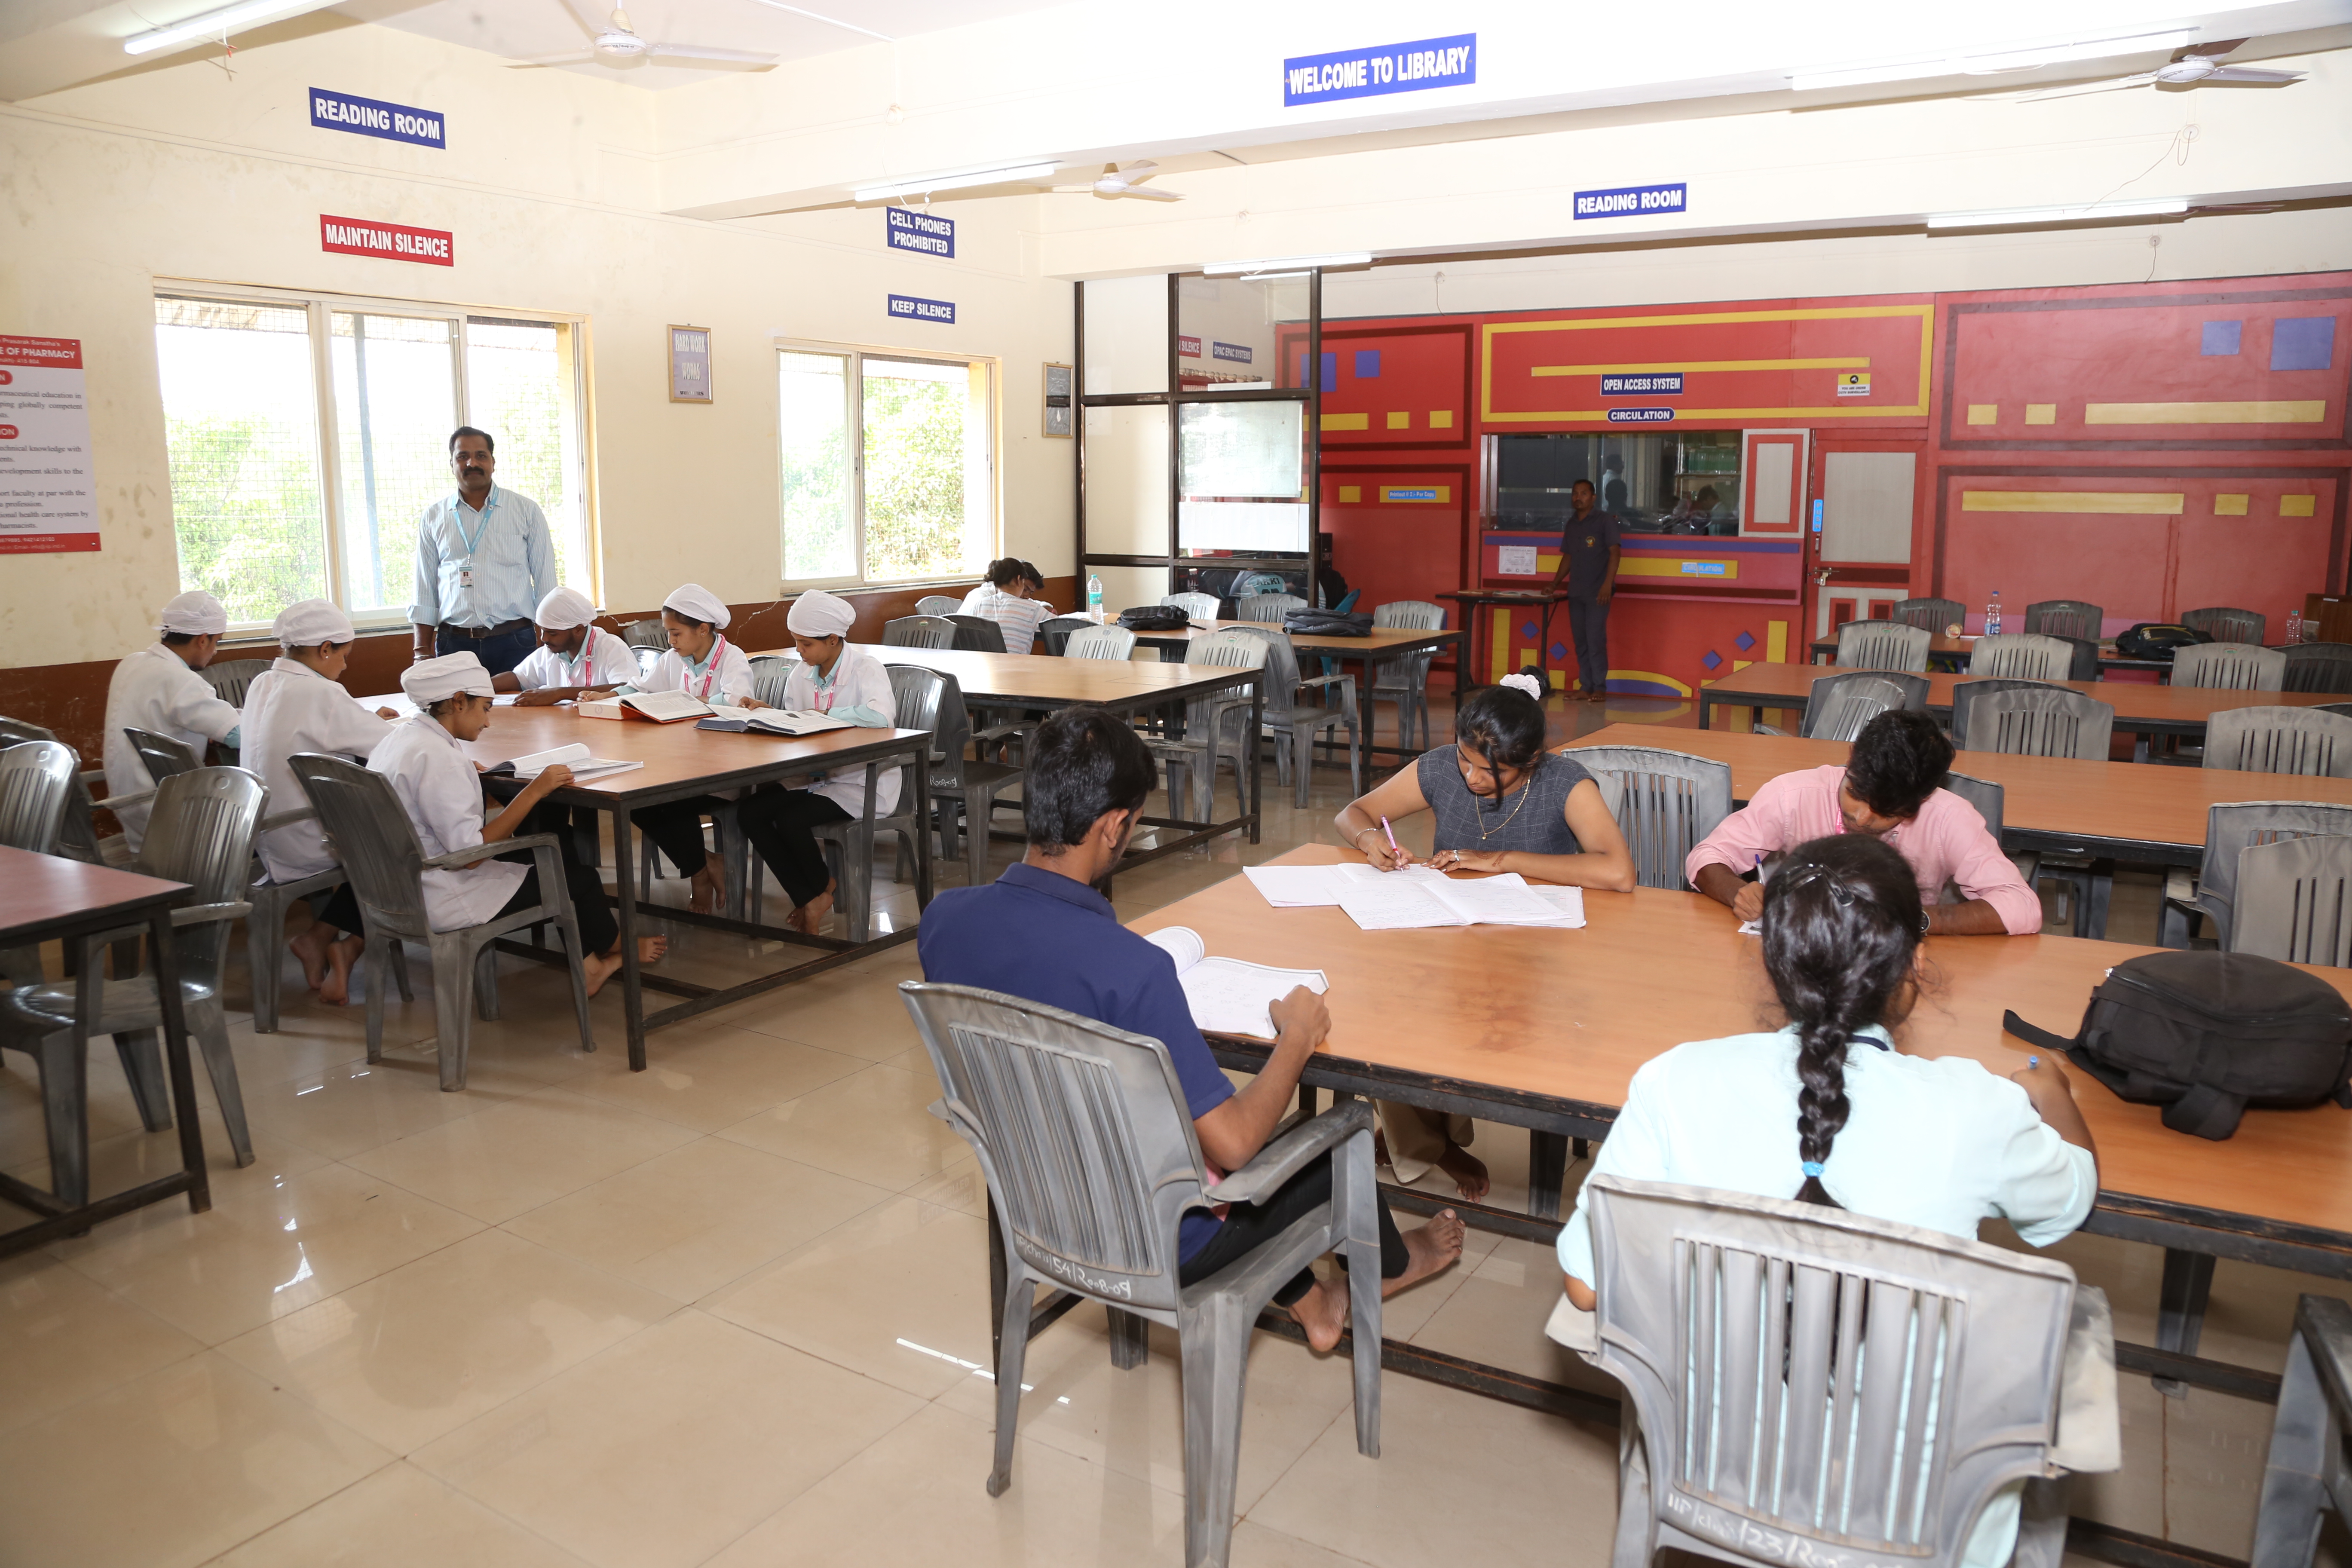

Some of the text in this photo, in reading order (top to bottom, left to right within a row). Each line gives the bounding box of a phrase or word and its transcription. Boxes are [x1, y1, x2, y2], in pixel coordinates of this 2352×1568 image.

[1289, 45, 1470, 95] WELCOME TO LIBRARY
[315, 97, 440, 140] READING ROOM
[1577, 190, 1682, 214] READING ROOM
[890, 211, 952, 236] CELL PHONES
[325, 223, 449, 258] MAINTAIN SILENCE
[894, 230, 948, 254] PROHIBITED
[891, 300, 952, 319] KEEP SILENCE
[6, 347, 20, 355] OF
[22, 348, 75, 359] PHARMACY
[675, 334, 706, 353] HARD WORK
[1182, 340, 1200, 353] SILENCE
[1214, 345, 1251, 360] OPAC EPAC SYSTEMS
[682, 362, 701, 381] WORKS
[1604, 377, 1681, 391] OPEN ACCESS SYSTEM
[1611, 410, 1670, 420] CIRCULATION
